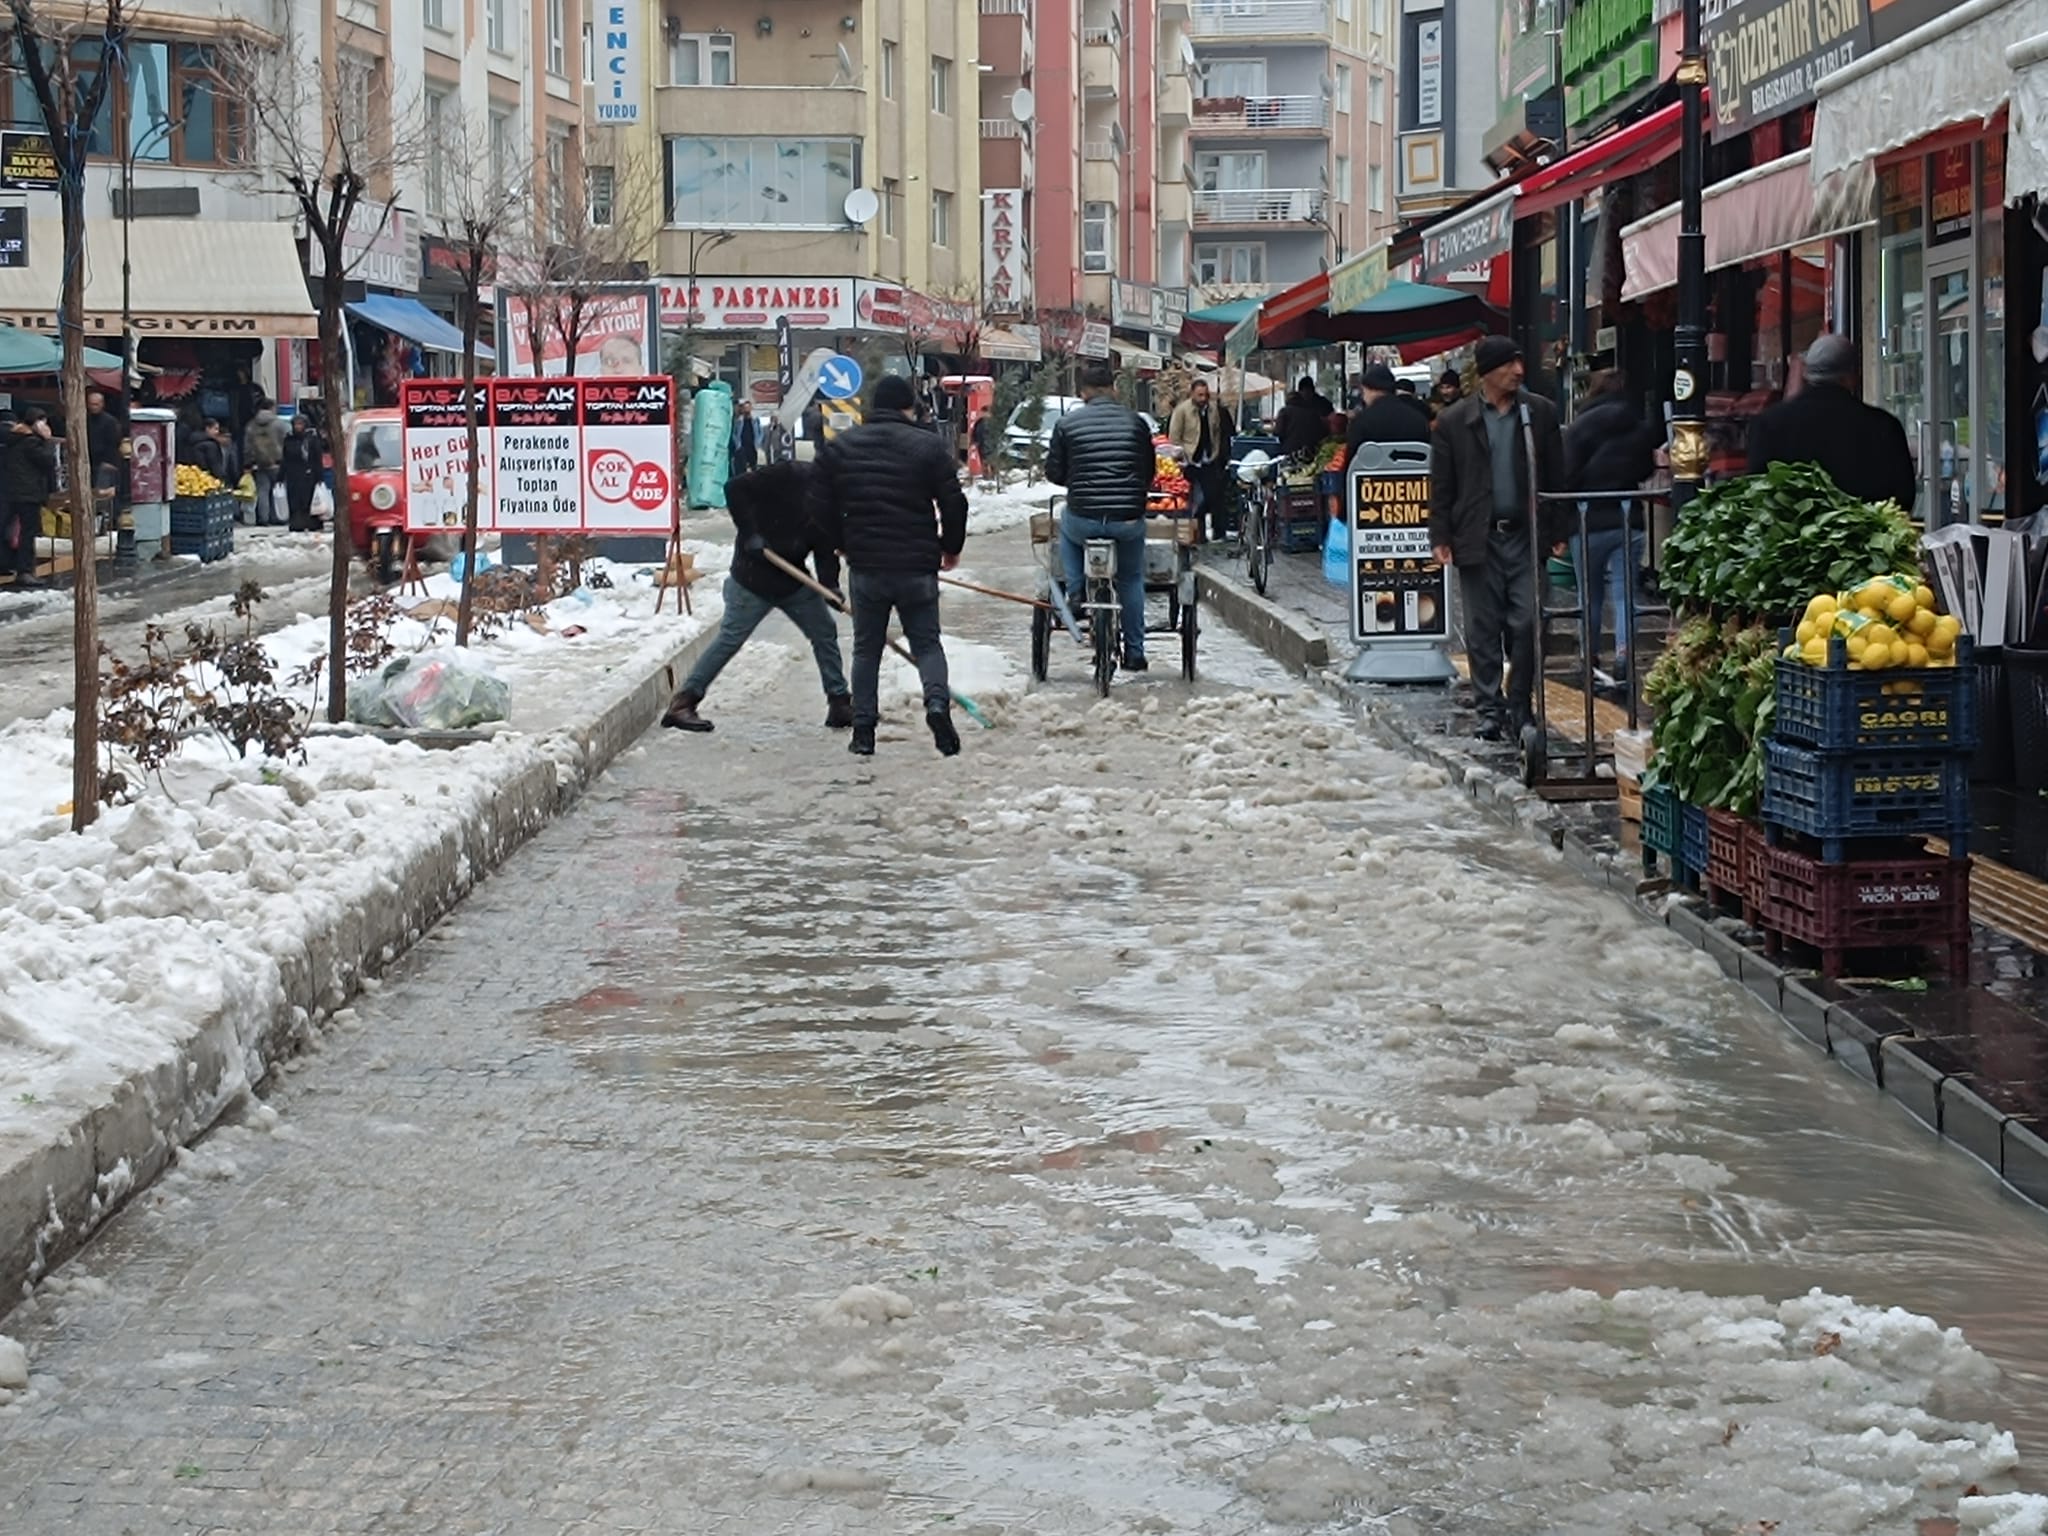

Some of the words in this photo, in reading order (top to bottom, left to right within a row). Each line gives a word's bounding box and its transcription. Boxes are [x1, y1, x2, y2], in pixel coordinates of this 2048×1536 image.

[1815, 0, 1859, 45] GSM
[1806, 63, 1814, 90] &
[598, 105, 637, 118] YURDU
[992, 192, 1012, 298] KARVAN
[712, 286, 840, 309] PASTANESİ
[134, 318, 256, 330] GİYİM
[411, 445, 440, 461] Her
[447, 435, 470, 453] Gü
[504, 435, 570, 450] Perakende
[446, 454, 487, 474] Fiyt
[596, 461, 627, 474] ÇOK
[517, 477, 557, 493] Toptan
[600, 476, 619, 487] AL
[637, 470, 659, 484] AZ
[632, 485, 664, 500] ÖDE
[1361, 476, 1431, 502] ÖZDEMİ
[500, 497, 548, 514] Fiyatına
[553, 494, 577, 512] Öde
[1381, 503, 1420, 524] GSM
